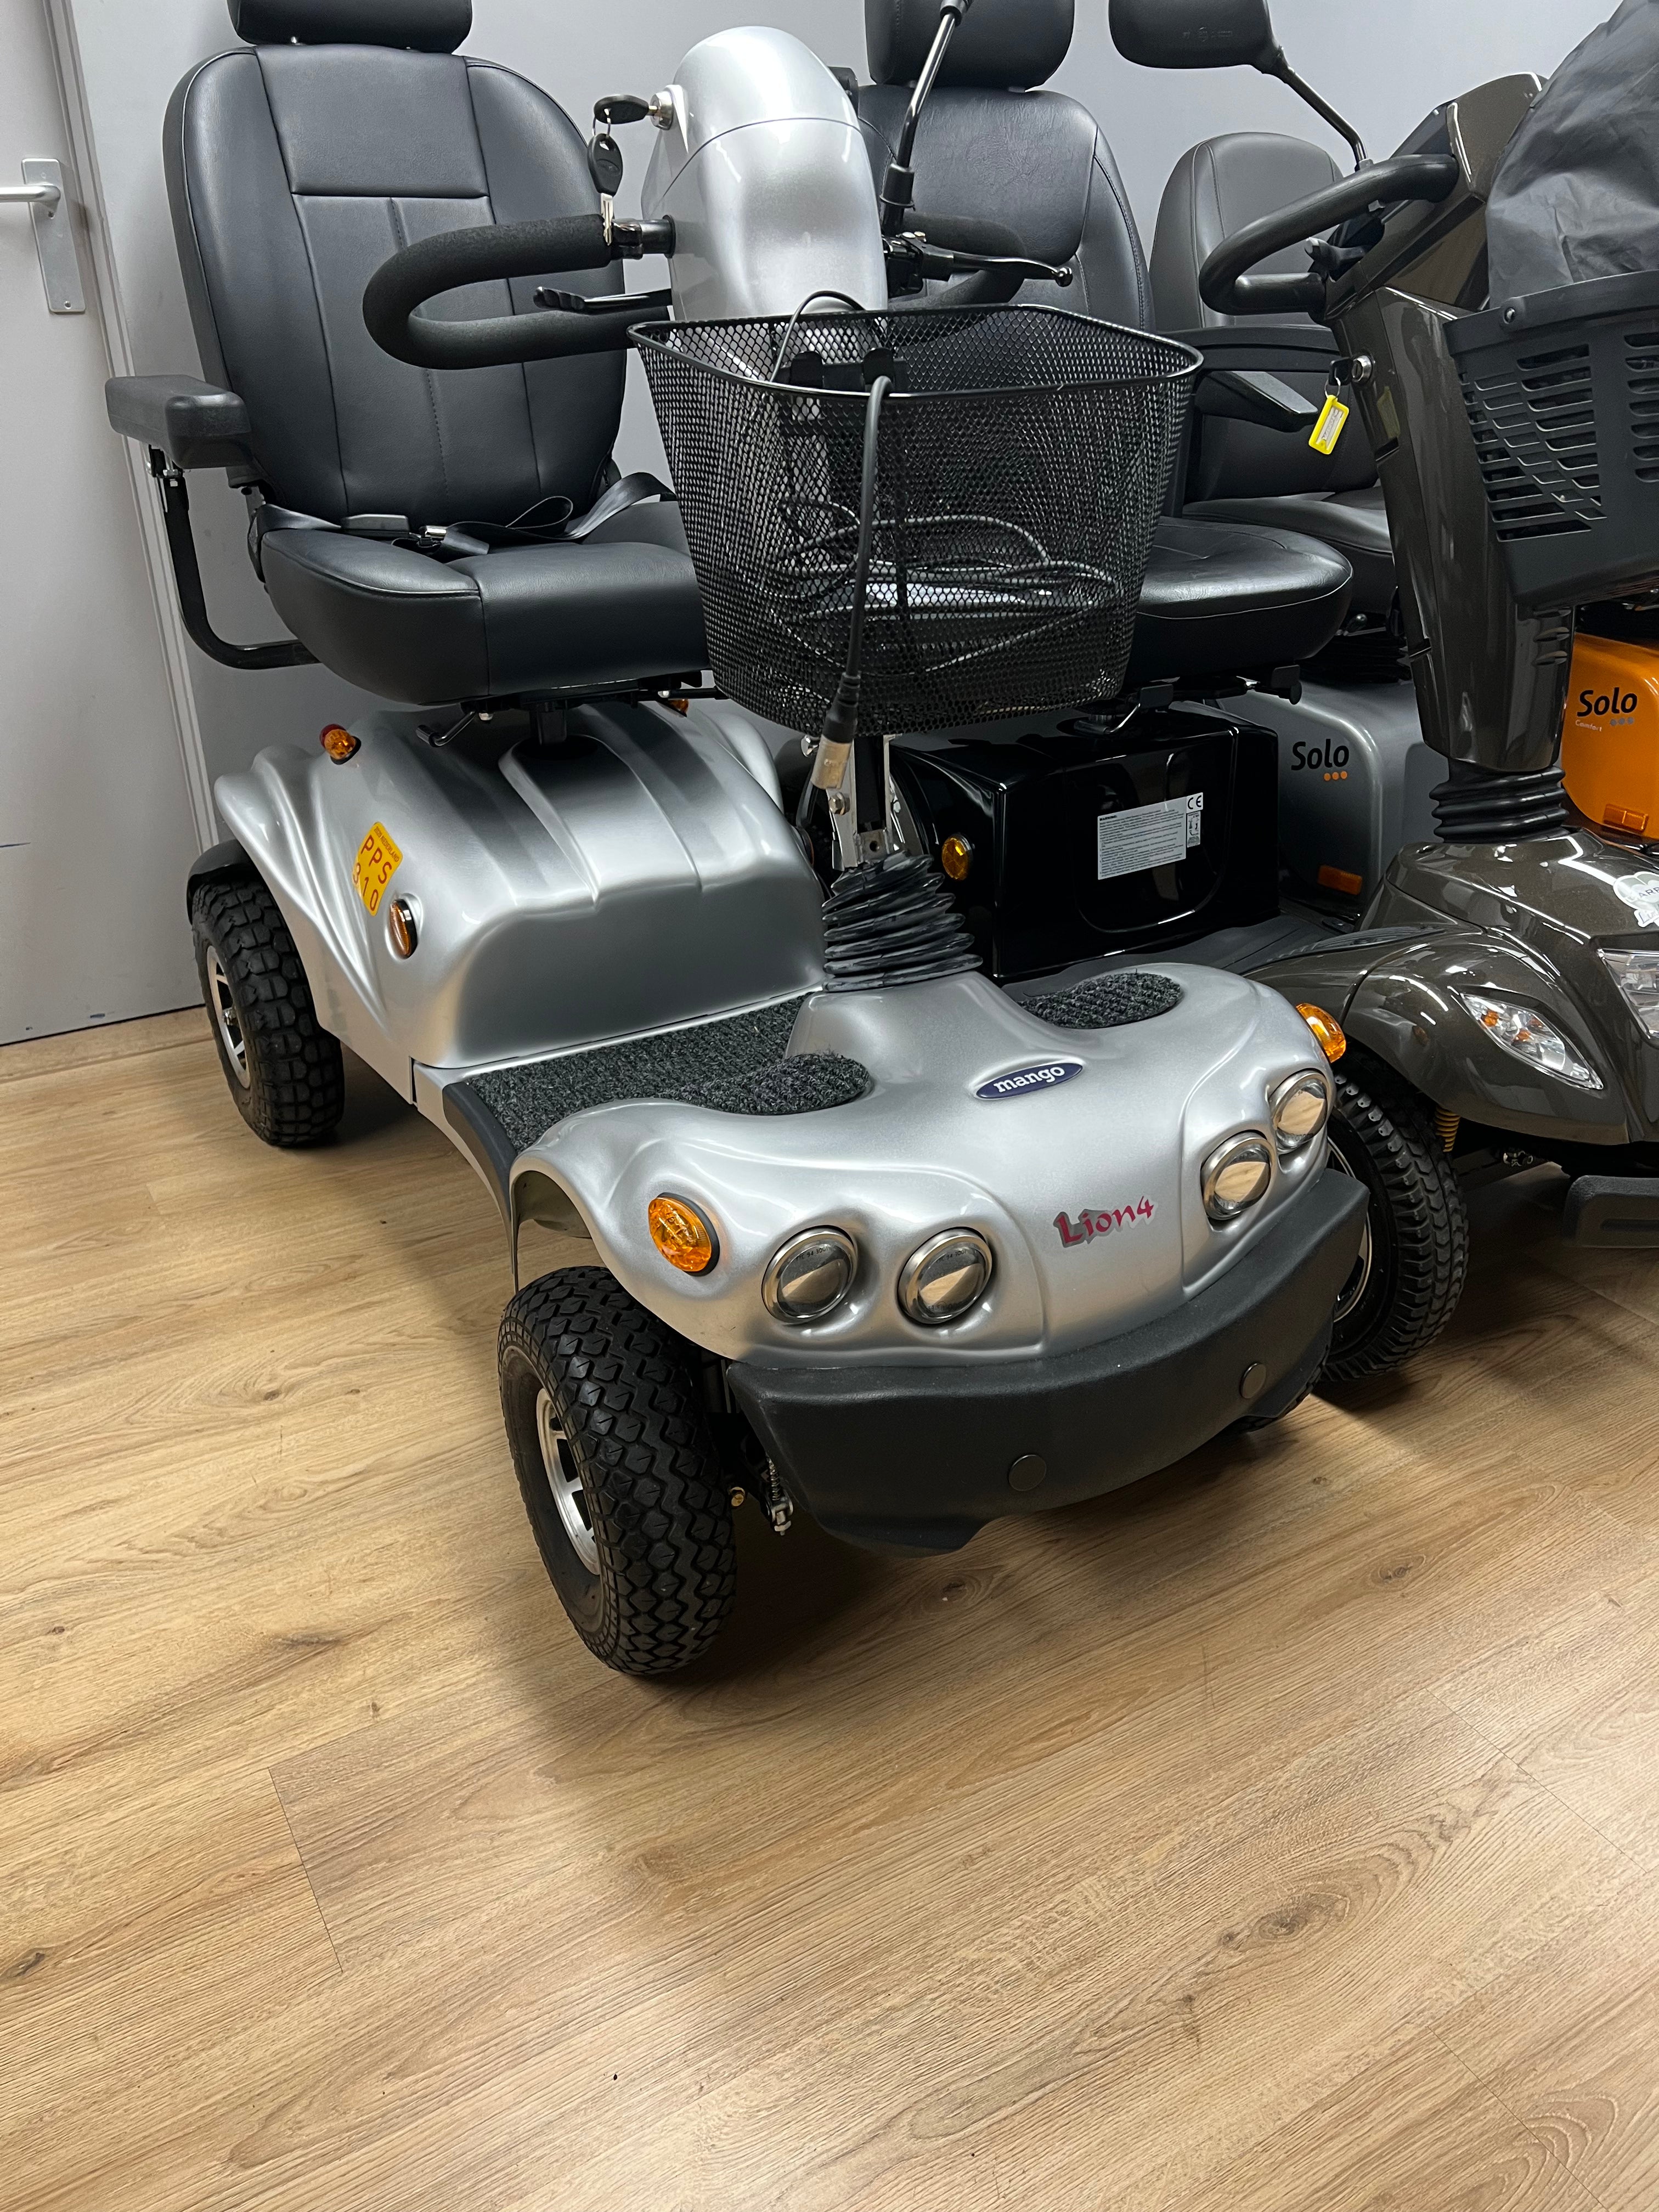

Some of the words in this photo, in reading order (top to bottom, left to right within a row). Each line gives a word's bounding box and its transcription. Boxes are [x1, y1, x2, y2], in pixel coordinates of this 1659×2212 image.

[1577, 687, 1638, 717] Solo
[1291, 738, 1350, 771] Solo
[360, 834, 392, 884] PPS
[993, 1066, 1065, 1093] mango
[1057, 1195, 1154, 1244] Lion4
